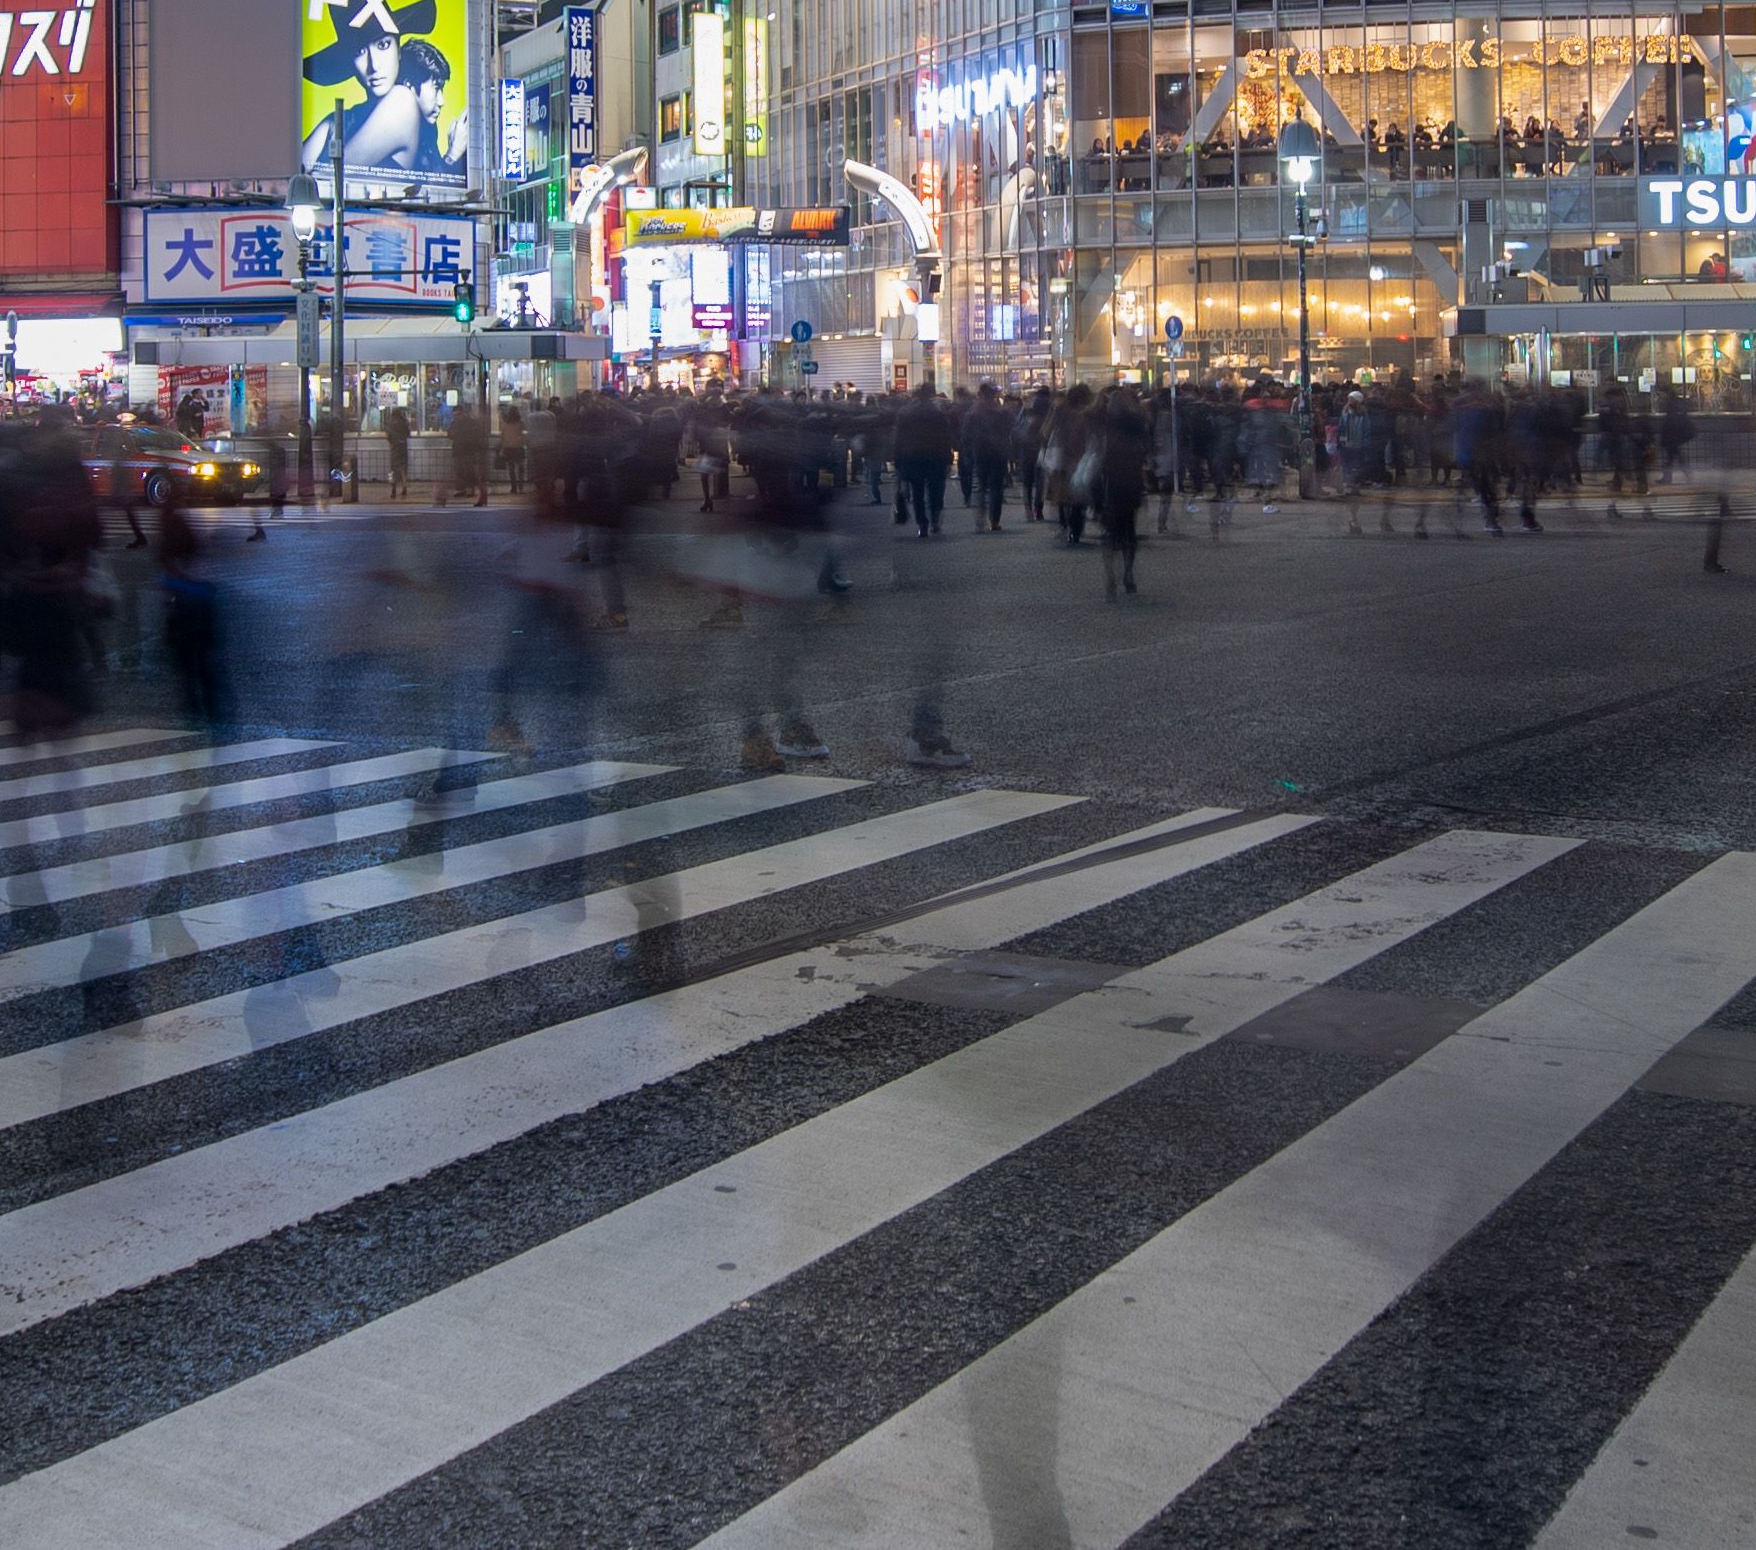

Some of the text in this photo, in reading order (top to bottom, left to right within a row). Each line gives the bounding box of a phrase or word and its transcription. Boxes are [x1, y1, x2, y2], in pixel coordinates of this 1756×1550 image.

[1245, 36, 1501, 78] STARBUCKS
[570, 16, 594, 154] 洋服の青山
[423, 288, 442, 297] BOOKS
[177, 316, 233, 325] TAISEIDO
[1235, 327, 1289, 339] COFFEE
